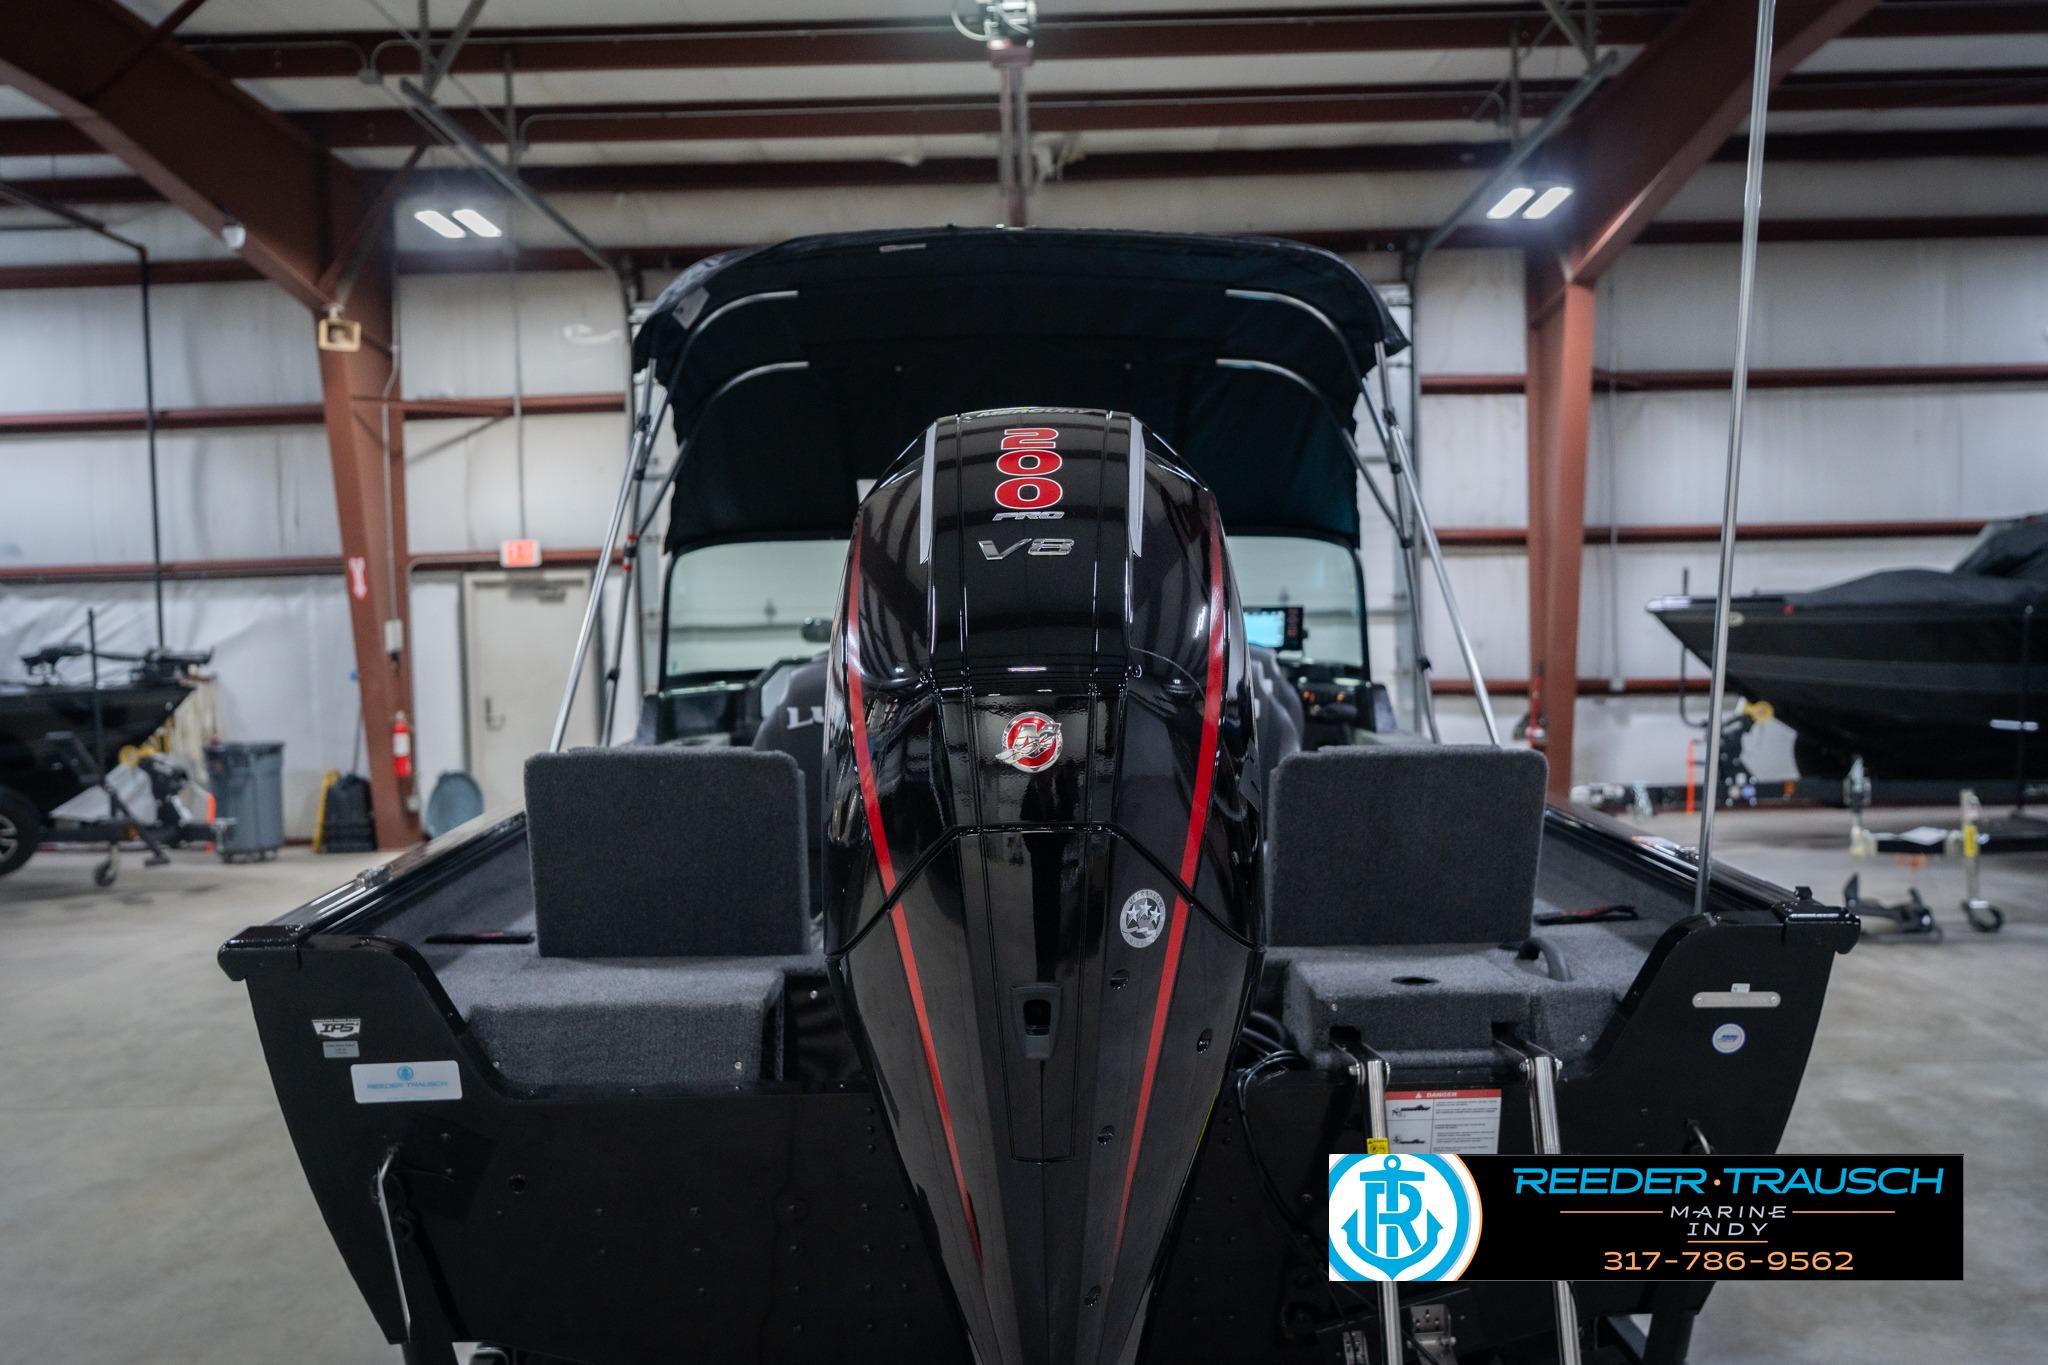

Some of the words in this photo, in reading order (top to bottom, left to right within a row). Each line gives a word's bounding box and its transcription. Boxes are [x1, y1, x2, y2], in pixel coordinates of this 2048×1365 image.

[994, 427, 1063, 510] 200
[992, 511, 1065, 521] PRO
[978, 538, 1075, 560] V8
